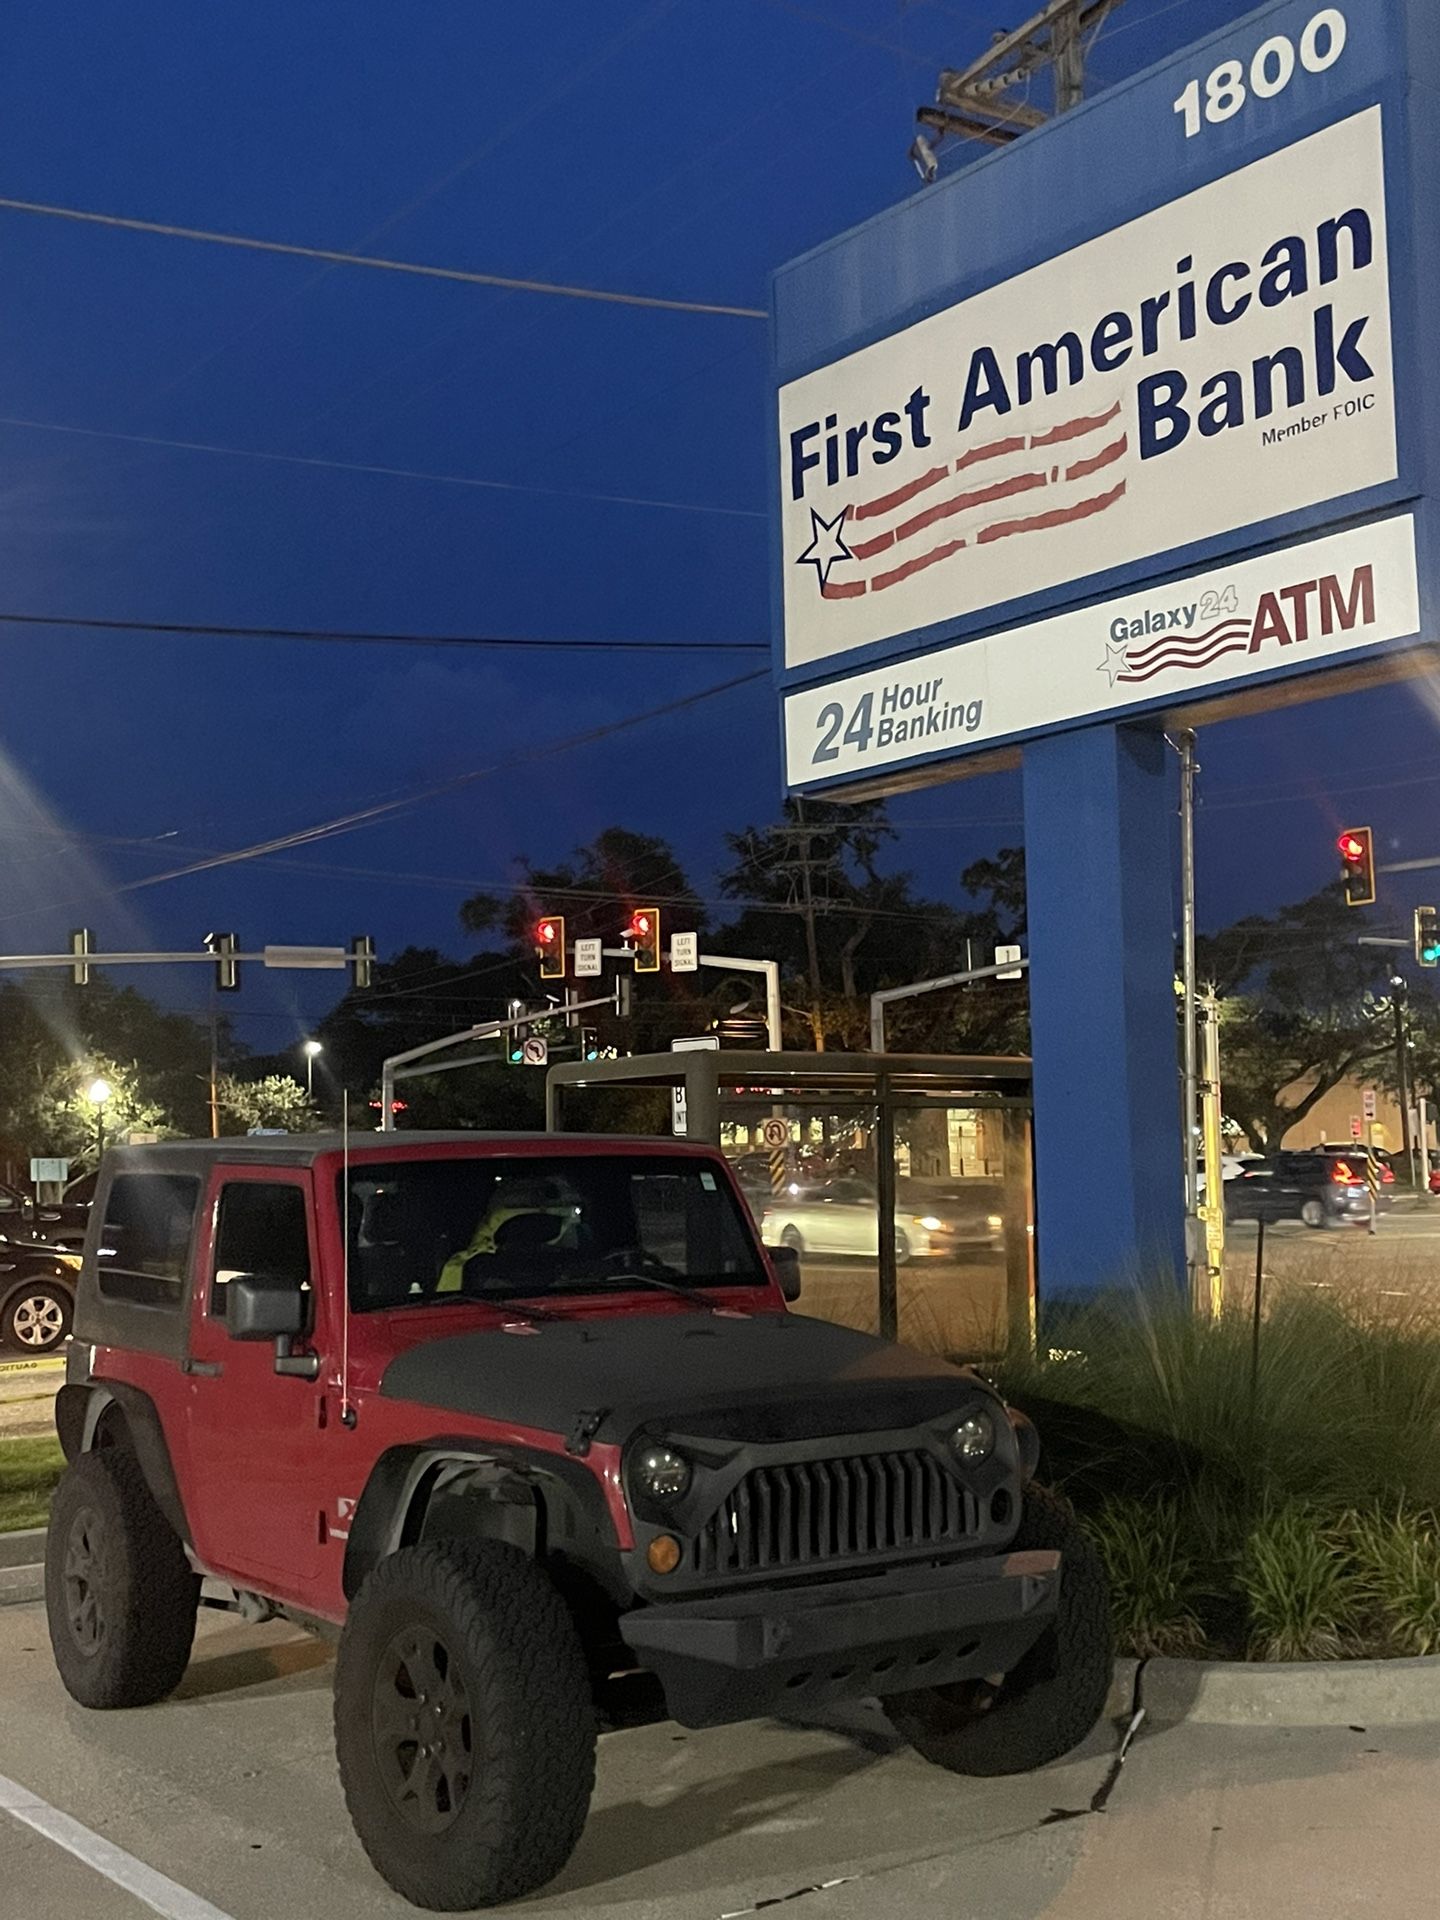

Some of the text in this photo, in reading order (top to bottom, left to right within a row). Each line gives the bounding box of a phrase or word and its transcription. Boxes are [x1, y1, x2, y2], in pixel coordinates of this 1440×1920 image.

[1174, 8, 1347, 138] 1800
[789, 207, 1373, 499] First American
[1137, 304, 1376, 460] Bank
[1262, 409, 1328, 446] Member
[1109, 584, 1240, 643] Galaxy 24
[1247, 563, 1376, 654] ATM
[811, 677, 943, 764] 24 Hour
[876, 699, 984, 748] Banking
